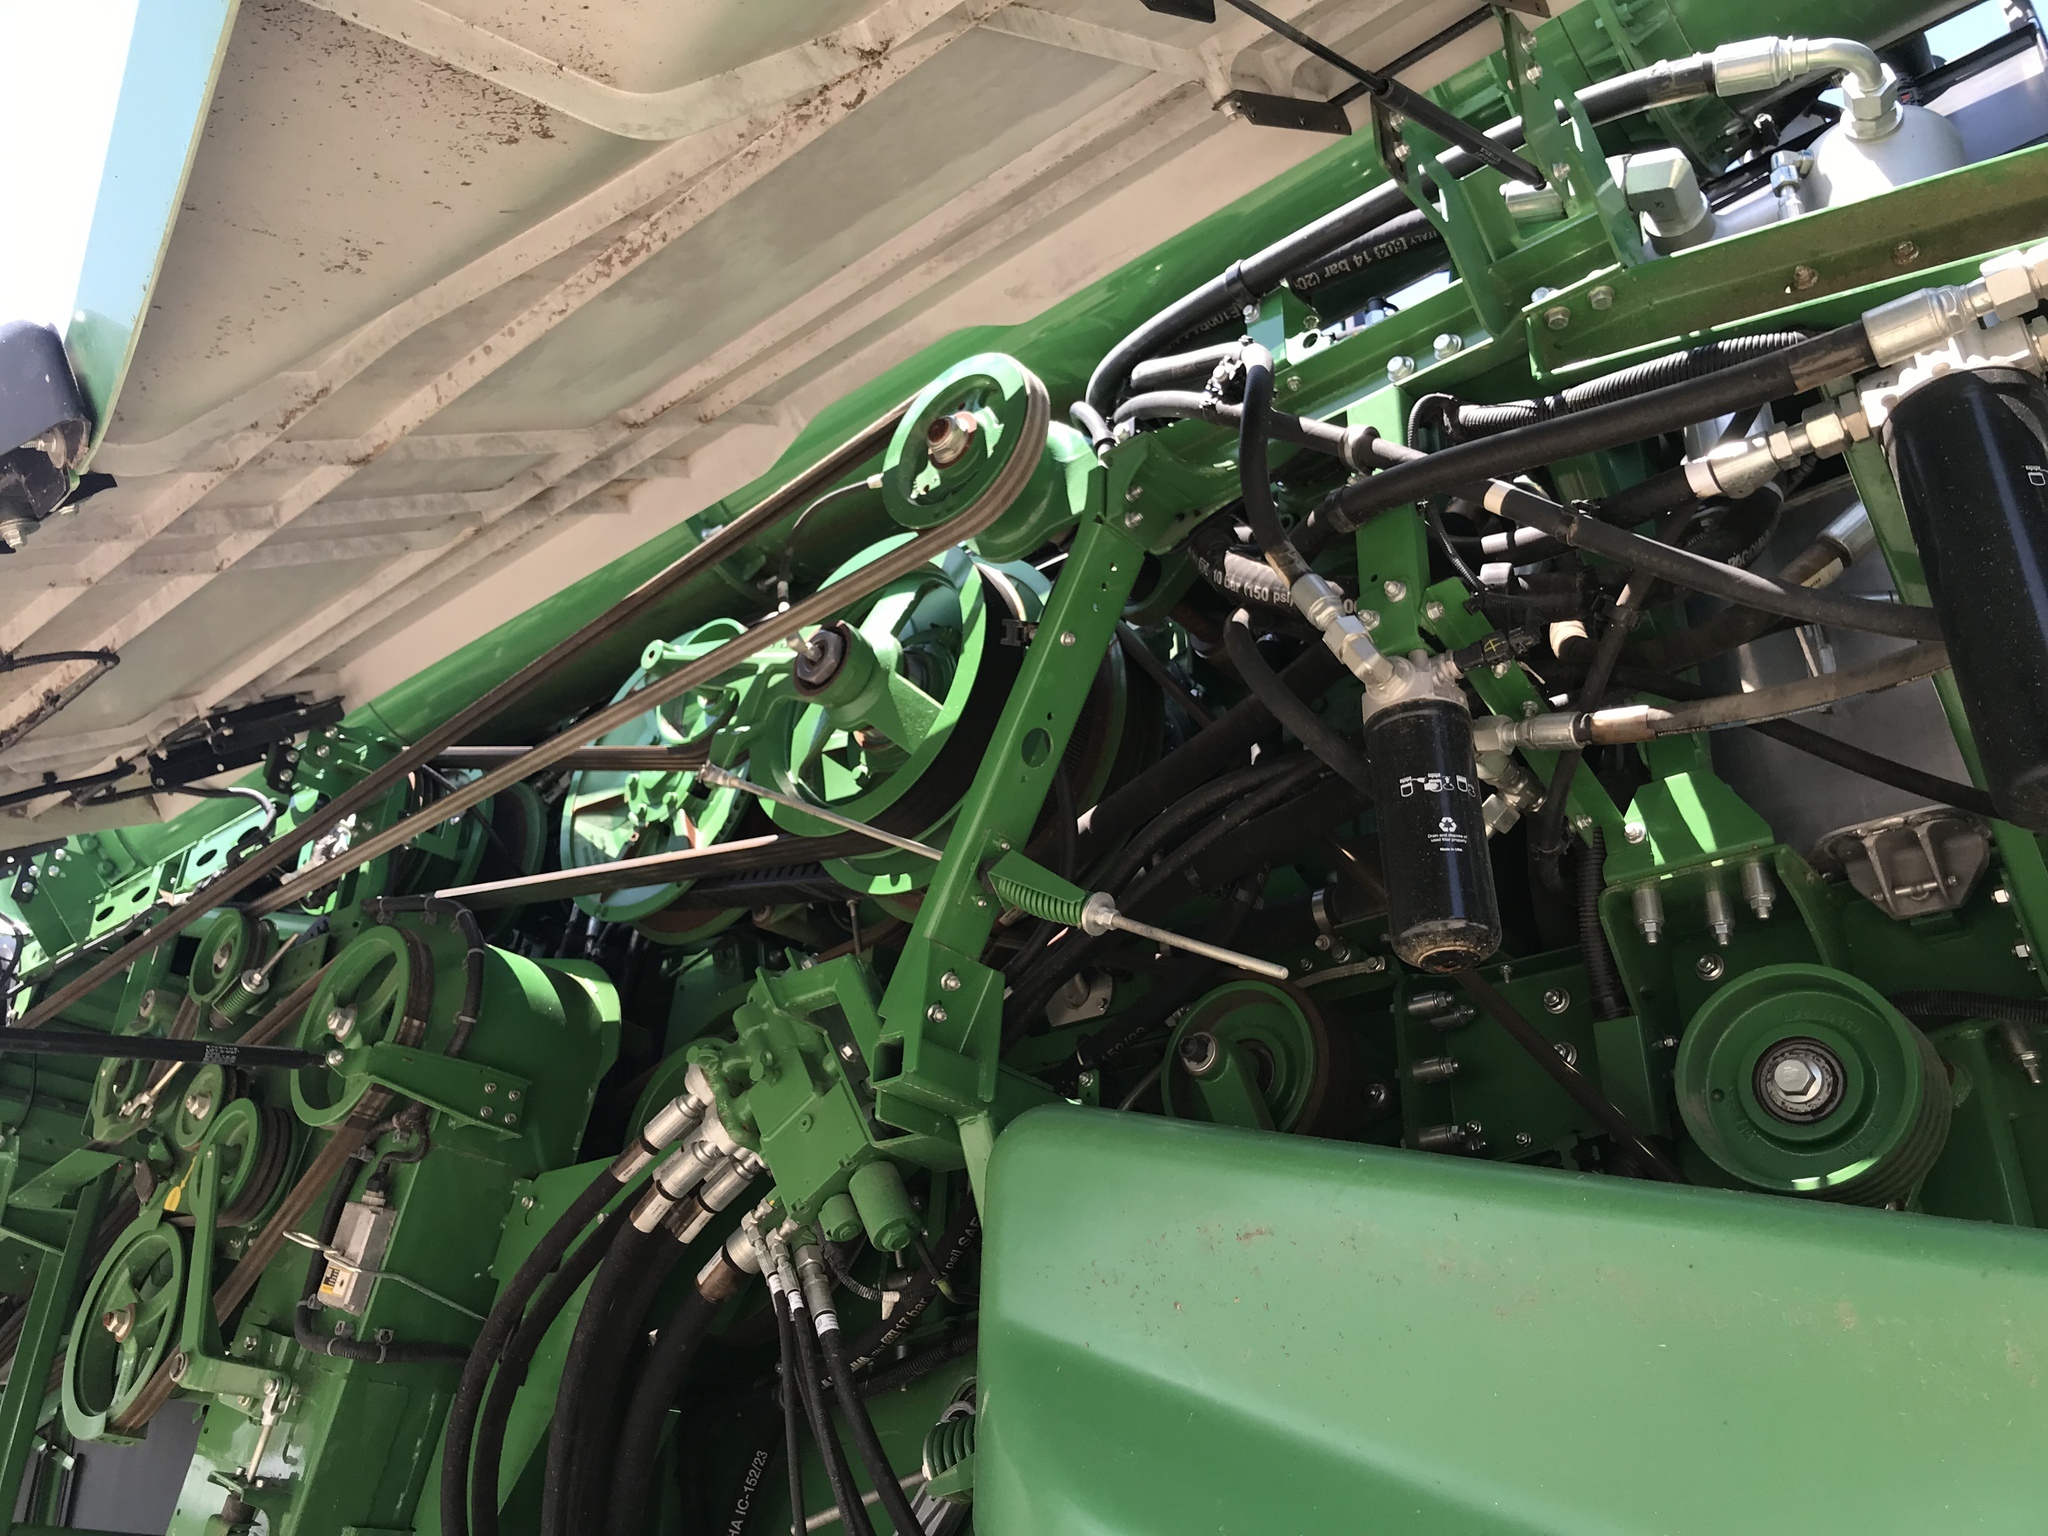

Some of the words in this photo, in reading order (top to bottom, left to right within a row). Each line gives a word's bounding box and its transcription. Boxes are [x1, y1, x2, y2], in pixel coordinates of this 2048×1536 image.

[1323, 260, 1350, 279] bar
[1353, 250, 1372, 267] 14
[1213, 571, 1222, 585] 10
[1224, 575, 1241, 593] bar
[1244, 583, 1268, 601] (150
[895, 1317, 910, 1334] 17
[906, 1298, 927, 1317] bar
[735, 1450, 768, 1515] IC-152/23
